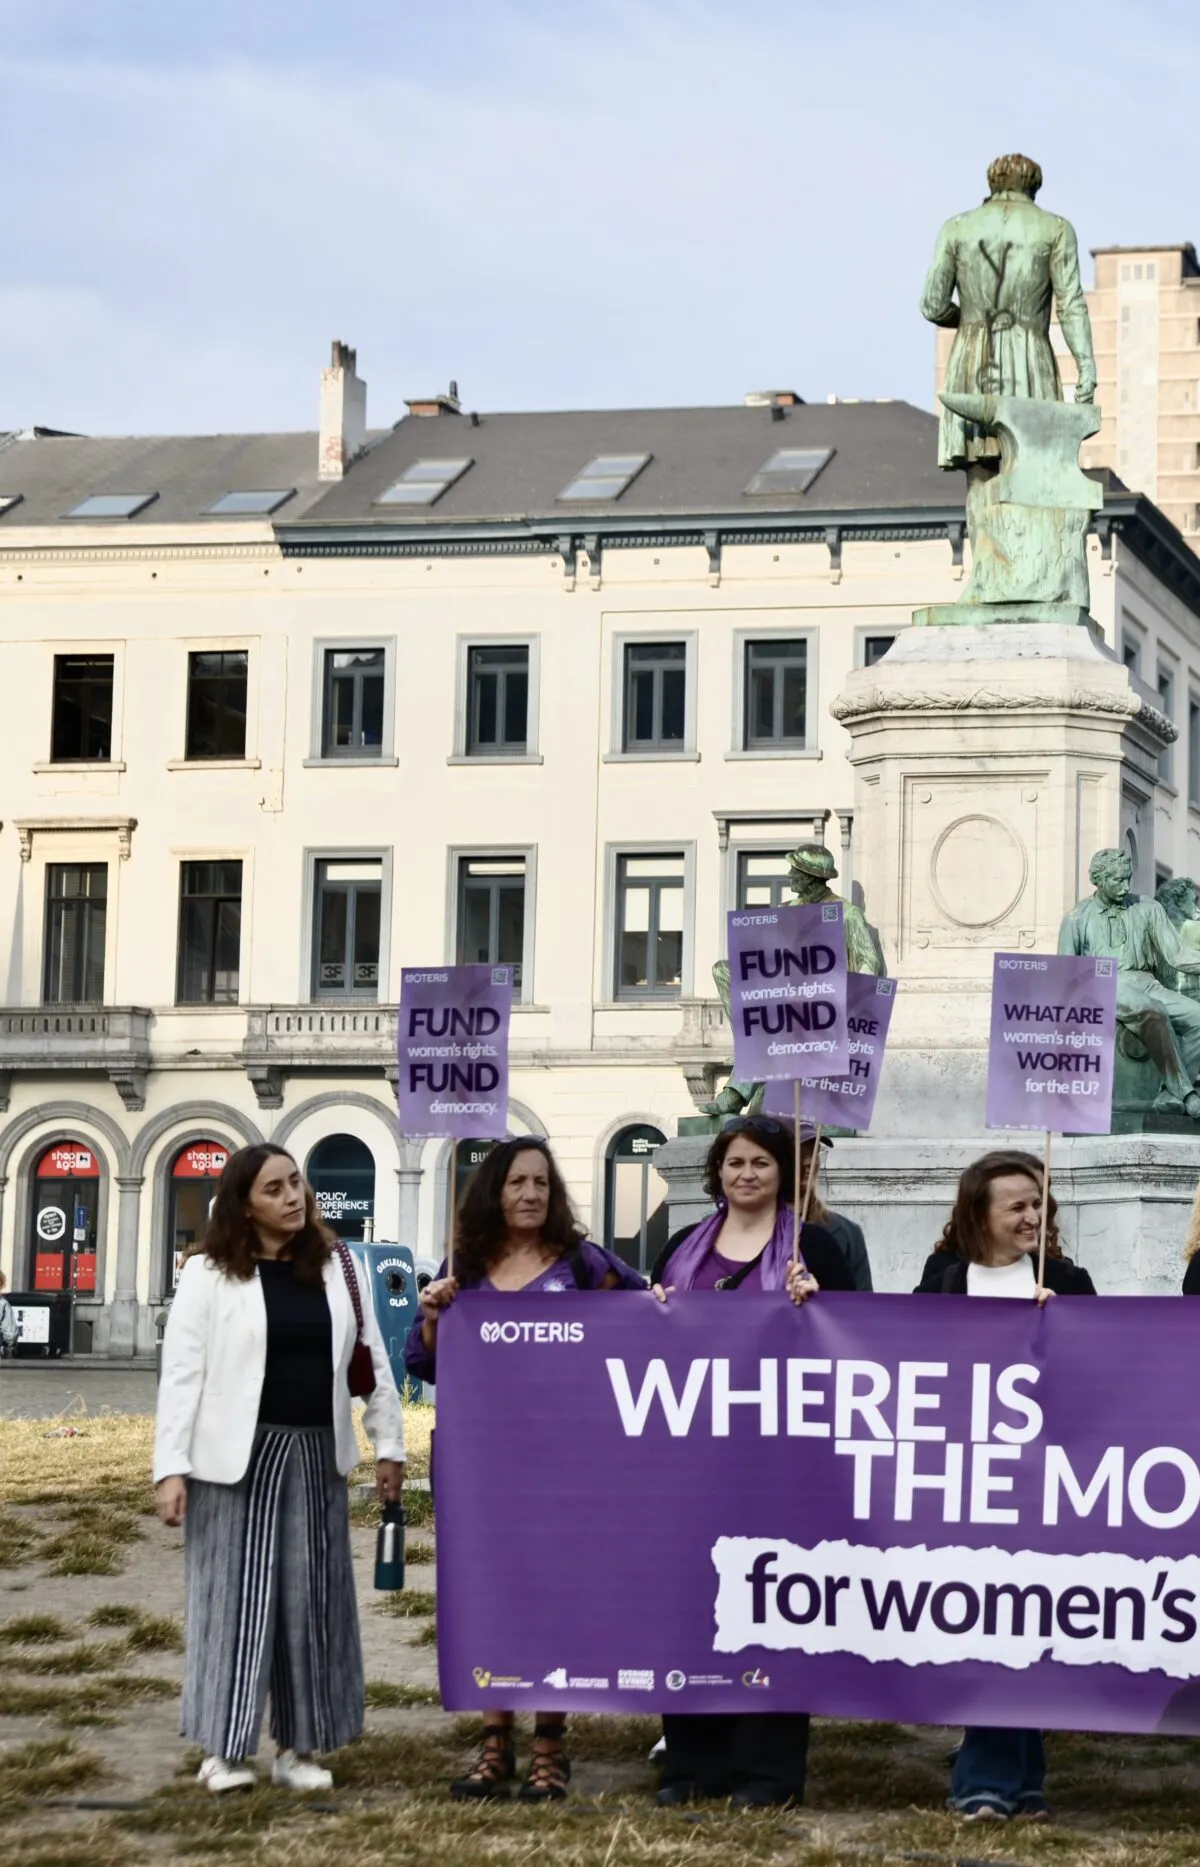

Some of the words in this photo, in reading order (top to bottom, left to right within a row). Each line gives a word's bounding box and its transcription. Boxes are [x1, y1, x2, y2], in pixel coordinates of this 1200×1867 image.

[740, 944, 836, 981] FUND
[741, 984, 797, 1001] women's
[799, 981, 836, 998] rights.
[408, 1007, 501, 1037] FUND
[743, 1000, 837, 1037] FUND
[1003, 1003, 1065, 1022] WHAT
[1065, 1006, 1104, 1025] ARE
[847, 1016, 879, 1036] ARE
[767, 1039, 838, 1056] democracy.
[847, 1039, 874, 1056] ights
[1003, 1030, 1064, 1045] women's
[1065, 1031, 1103, 1048] rights
[407, 1043, 461, 1058] women's
[463, 1042, 499, 1059] rights.
[1016, 1051, 1101, 1073] WORTH
[409, 1063, 500, 1093] FUND
[801, 1075, 818, 1088] for
[819, 1077, 840, 1091] the
[841, 1081, 867, 1096] EU?
[1025, 1078, 1047, 1094] for
[1047, 1079, 1070, 1093] the
[1071, 1080, 1100, 1096] EU?
[429, 1100, 499, 1117] democracy.
[51, 1150, 76, 1161] shop
[187, 1150, 212, 1161] shop
[470, 1152, 489, 1163] BU
[56, 1160, 76, 1170] &go
[192, 1160, 212, 1171] &go
[315, 1192, 348, 1201] POLICY
[316, 1201, 369, 1210] EXPERIENCE
[376, 1257, 413, 1274] GEKLEURD
[389, 1297, 409, 1307] GLAS
[605, 1357, 948, 1441] WHERE
[971, 1362, 1044, 1445] IS
[834, 1439, 1021, 1524] THE
[745, 1551, 850, 1627] for
[860, 1570, 1197, 1643] women's
